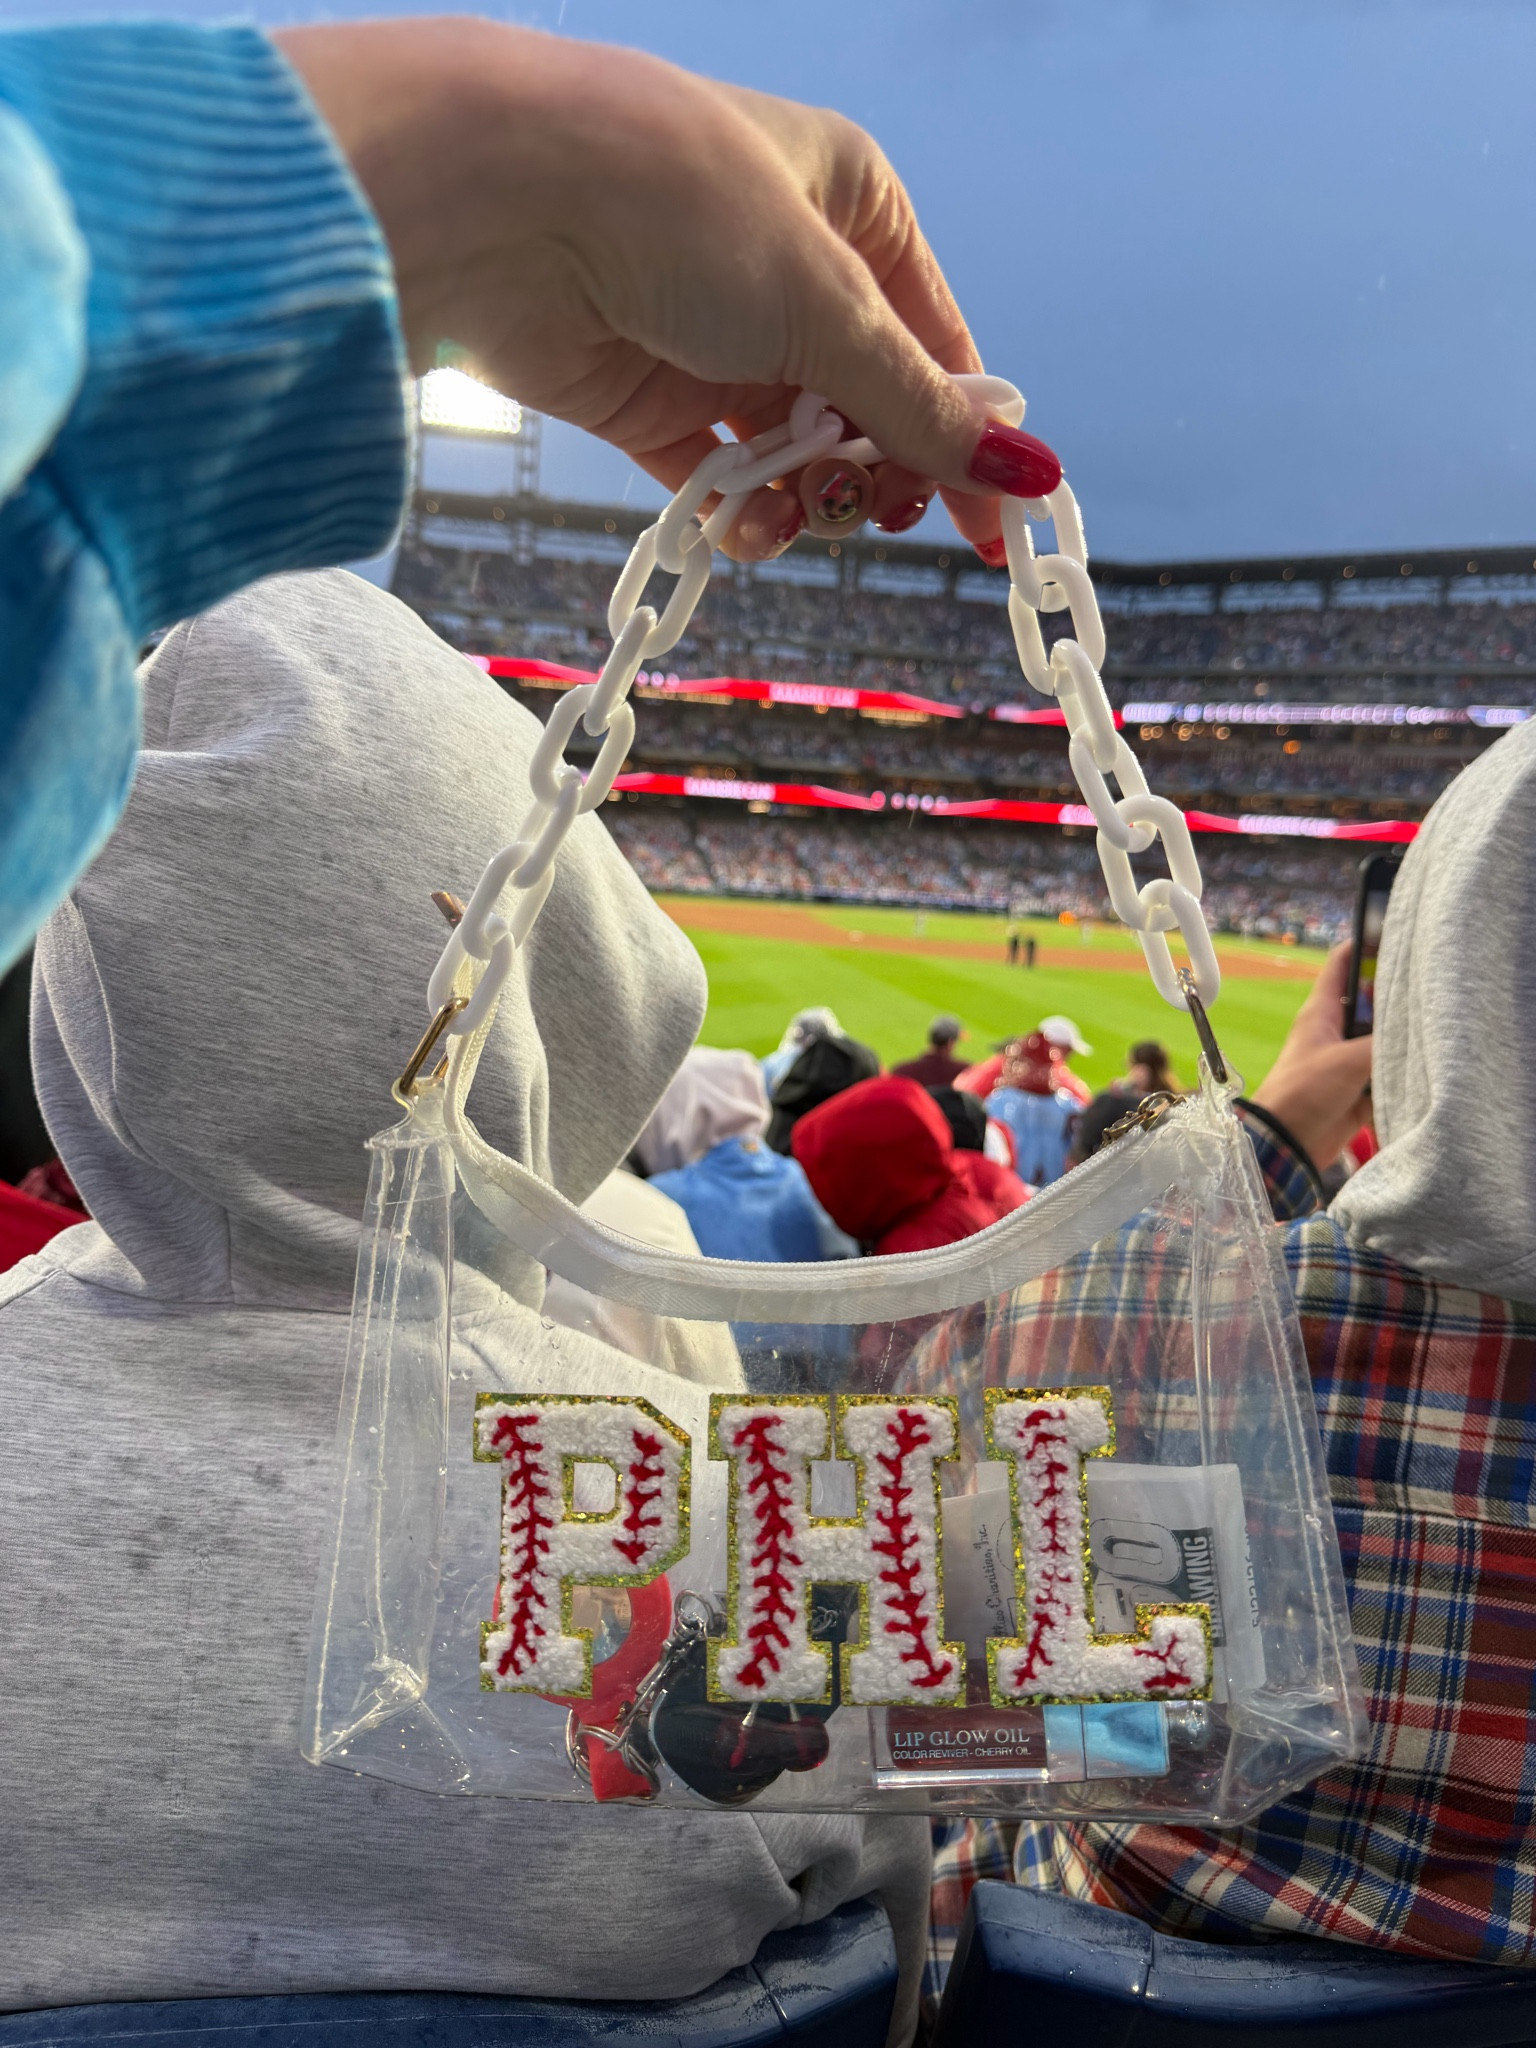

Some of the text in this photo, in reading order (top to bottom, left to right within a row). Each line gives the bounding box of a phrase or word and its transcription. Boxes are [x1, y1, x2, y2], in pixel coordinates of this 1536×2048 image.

[473, 1385, 1215, 1708] PHL
[893, 1728, 1030, 1747] LIP GLOW OIL
[893, 1750, 927, 1760] COLOR
[929, 1748, 968, 1759] REVIVER
[975, 1746, 1013, 1757] CHERRY
[1015, 1746, 1032, 1756] OIL
